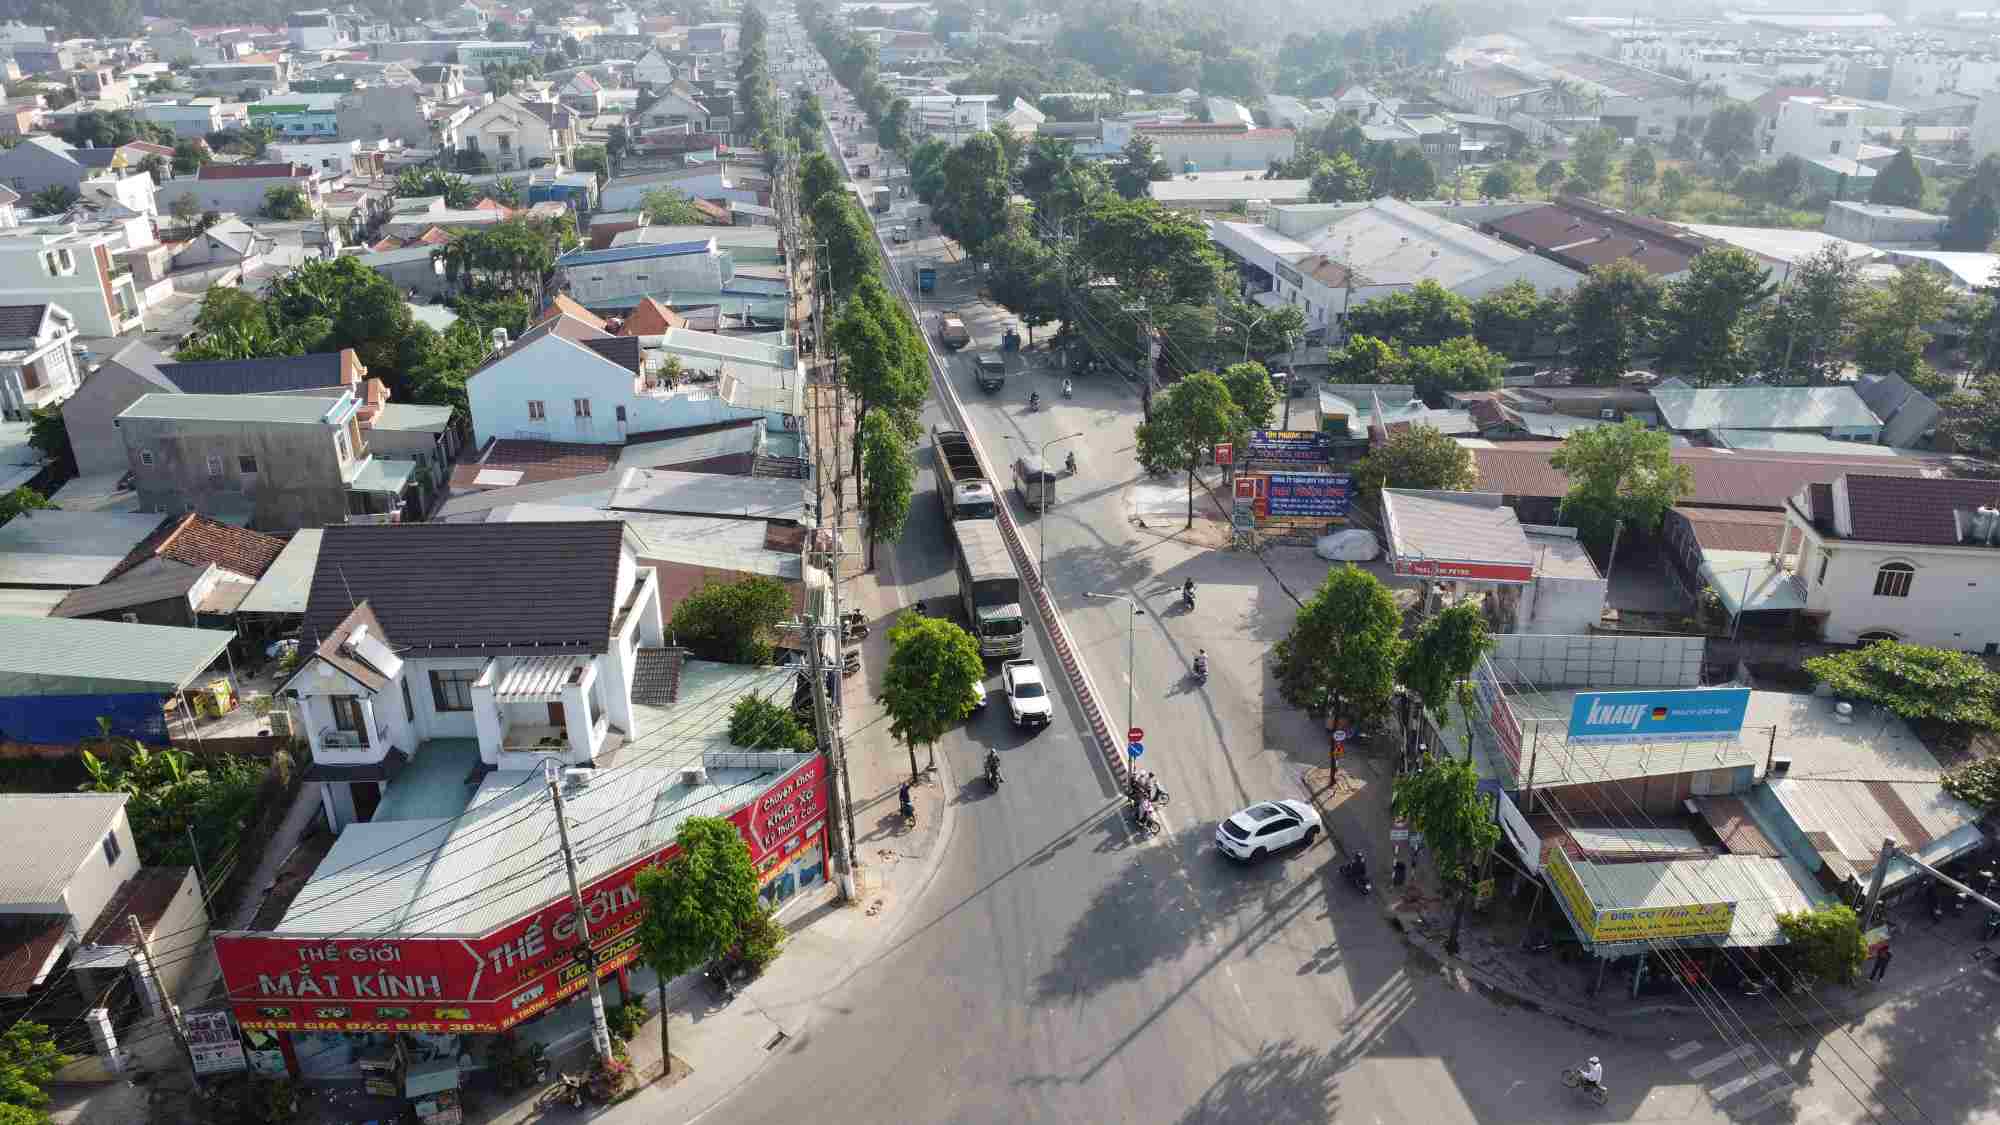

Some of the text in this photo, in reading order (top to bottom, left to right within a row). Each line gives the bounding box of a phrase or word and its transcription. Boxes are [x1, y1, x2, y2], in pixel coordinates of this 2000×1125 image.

[300, 942, 401, 962] THẾ GIỚI
[488, 915, 546, 974] THẾ
[257, 964, 442, 998] MẮT KÍNH
